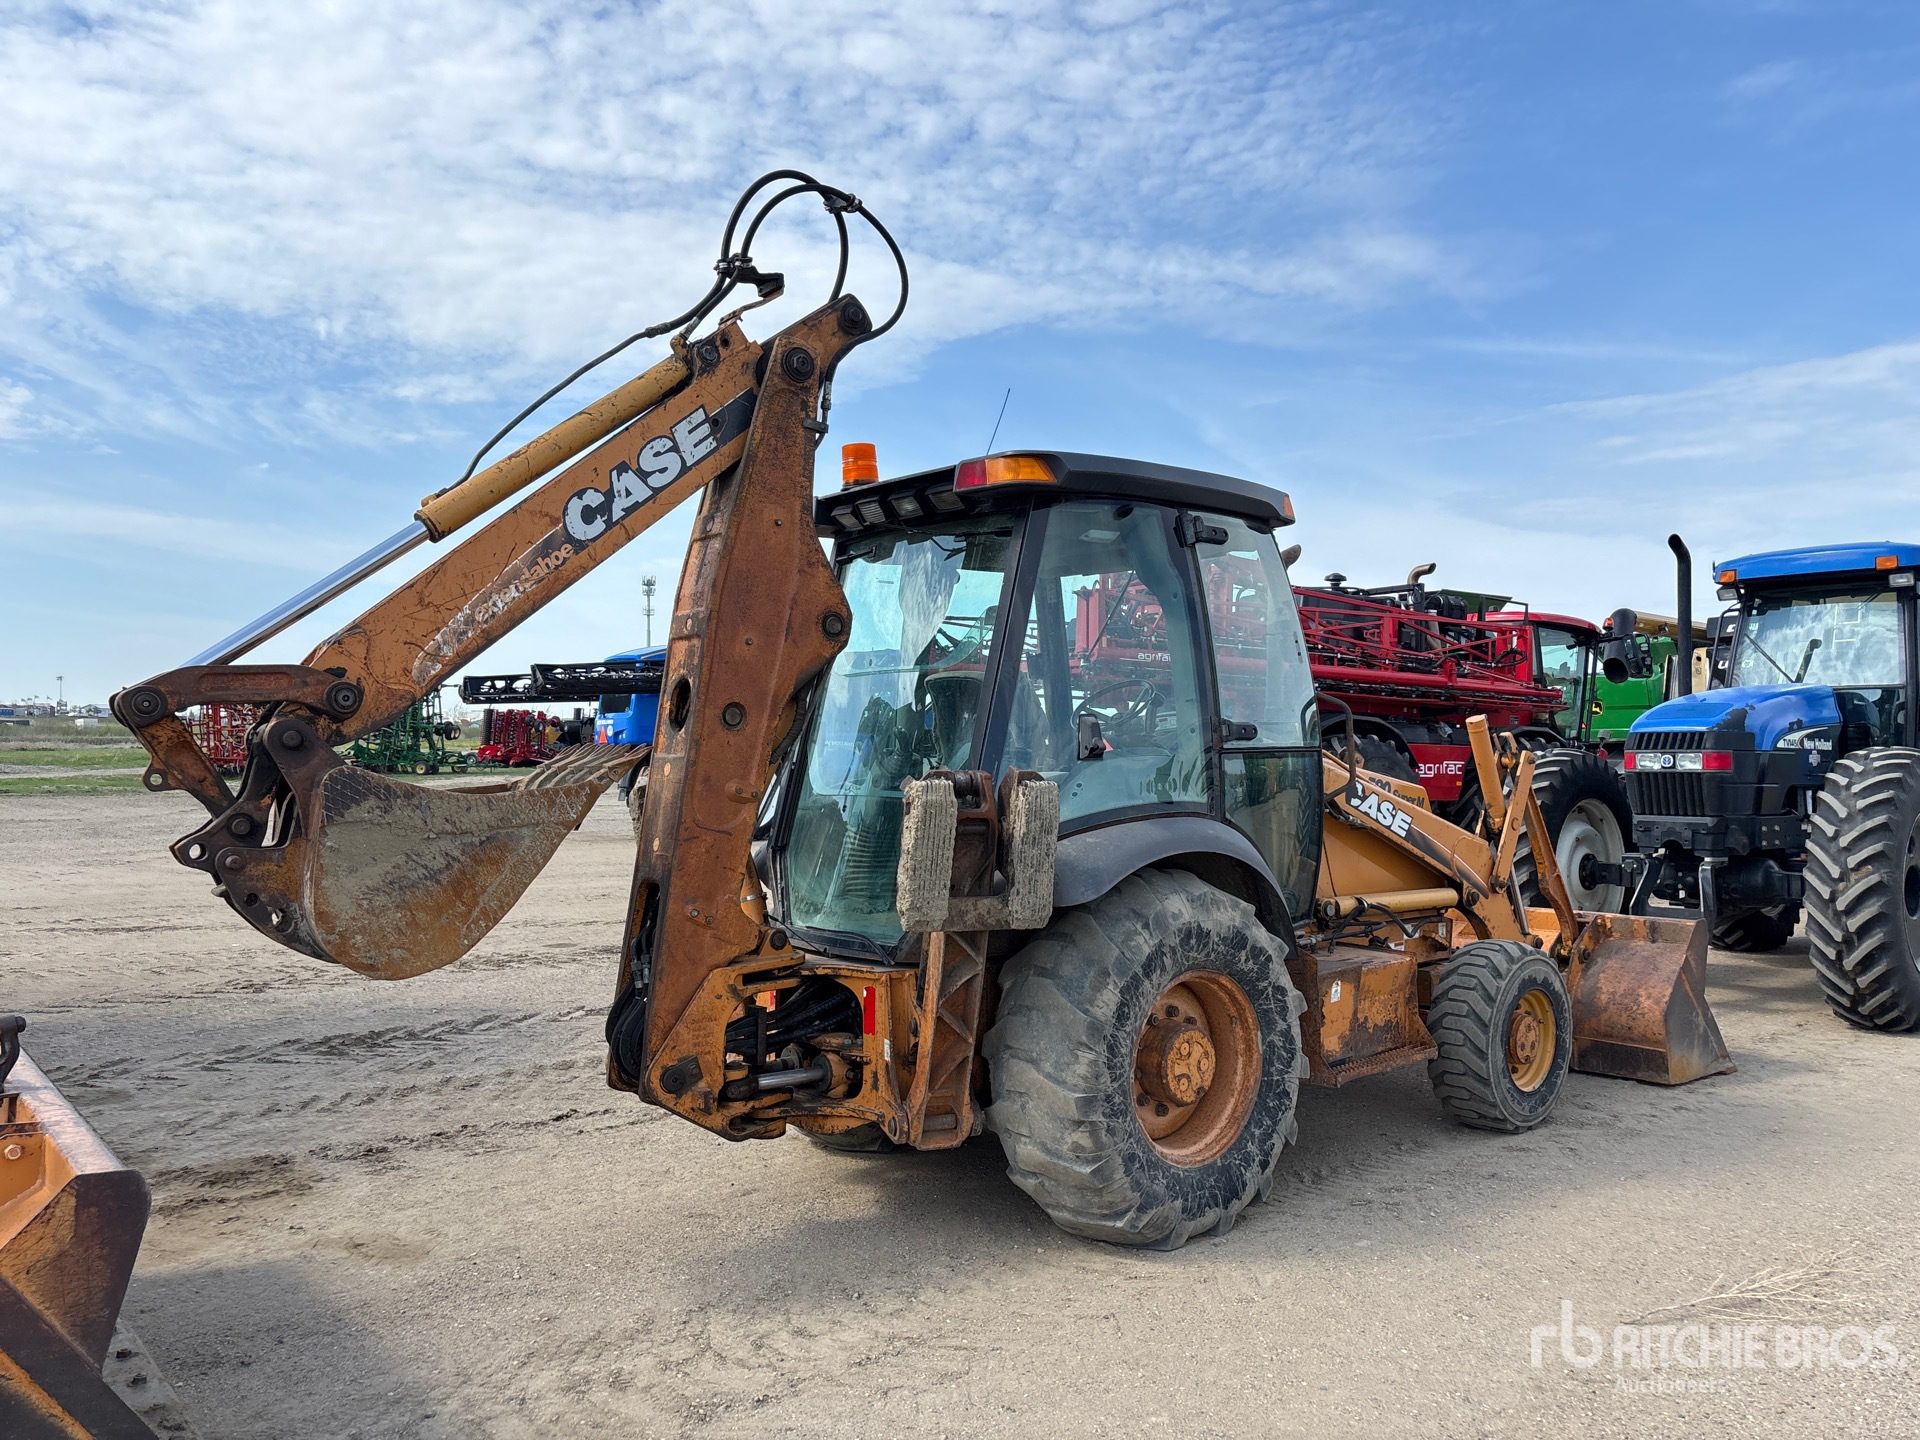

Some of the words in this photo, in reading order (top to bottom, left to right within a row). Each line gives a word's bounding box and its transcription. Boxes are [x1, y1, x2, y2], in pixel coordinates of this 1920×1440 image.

[564, 406, 718, 541] CASE
[1803, 737, 1815, 749] New
[1815, 738, 1832, 750] Holland
[1415, 760, 1465, 778] agrifac
